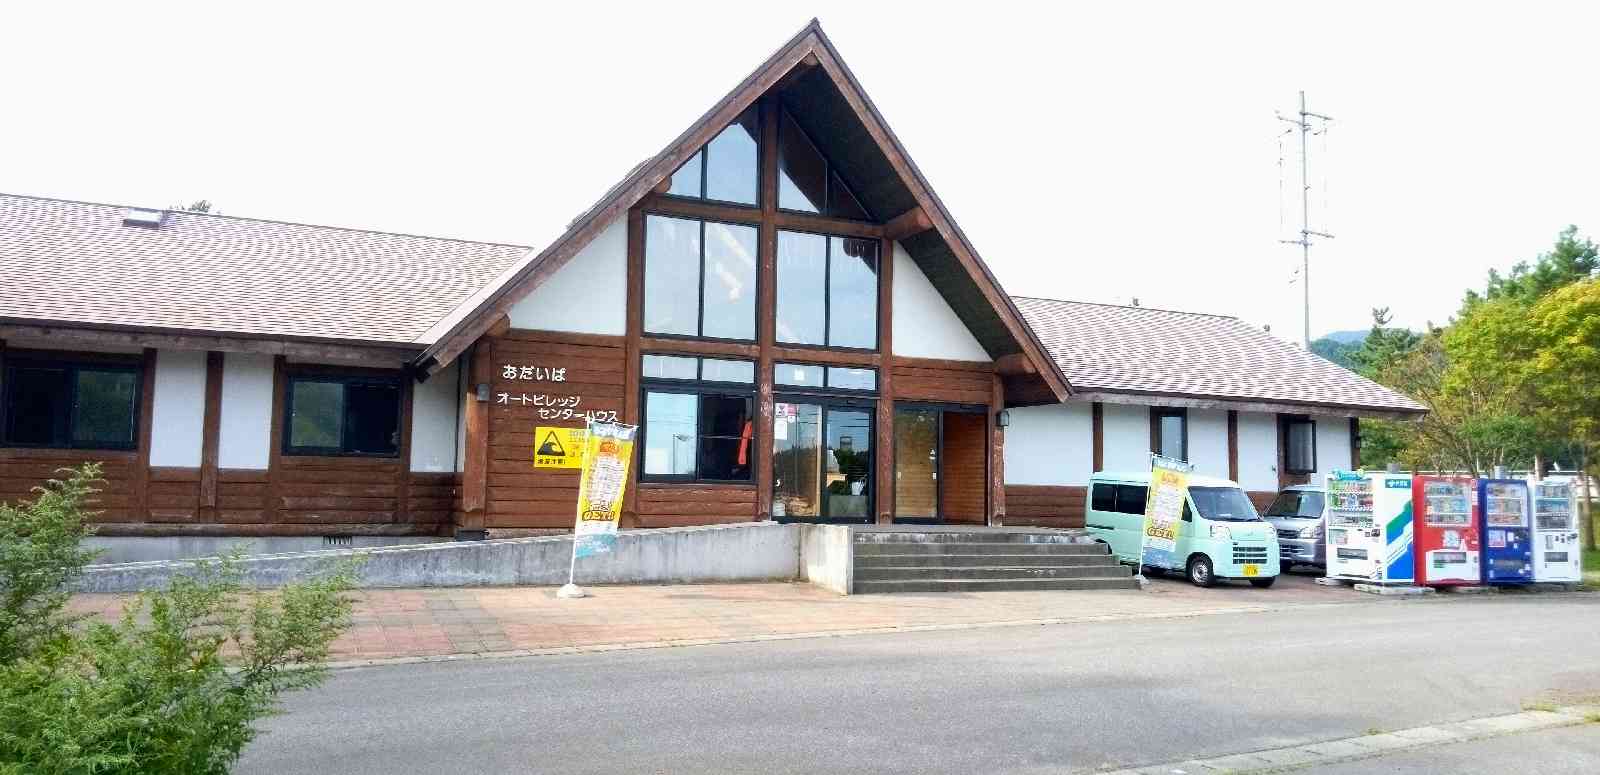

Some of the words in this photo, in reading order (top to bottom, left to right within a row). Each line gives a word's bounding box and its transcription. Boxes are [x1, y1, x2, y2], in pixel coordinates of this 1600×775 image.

[502, 364, 566, 381] おだいば
[497, 392, 580, 407] オートビレッジ
[538, 407, 618, 421] センターハウス
